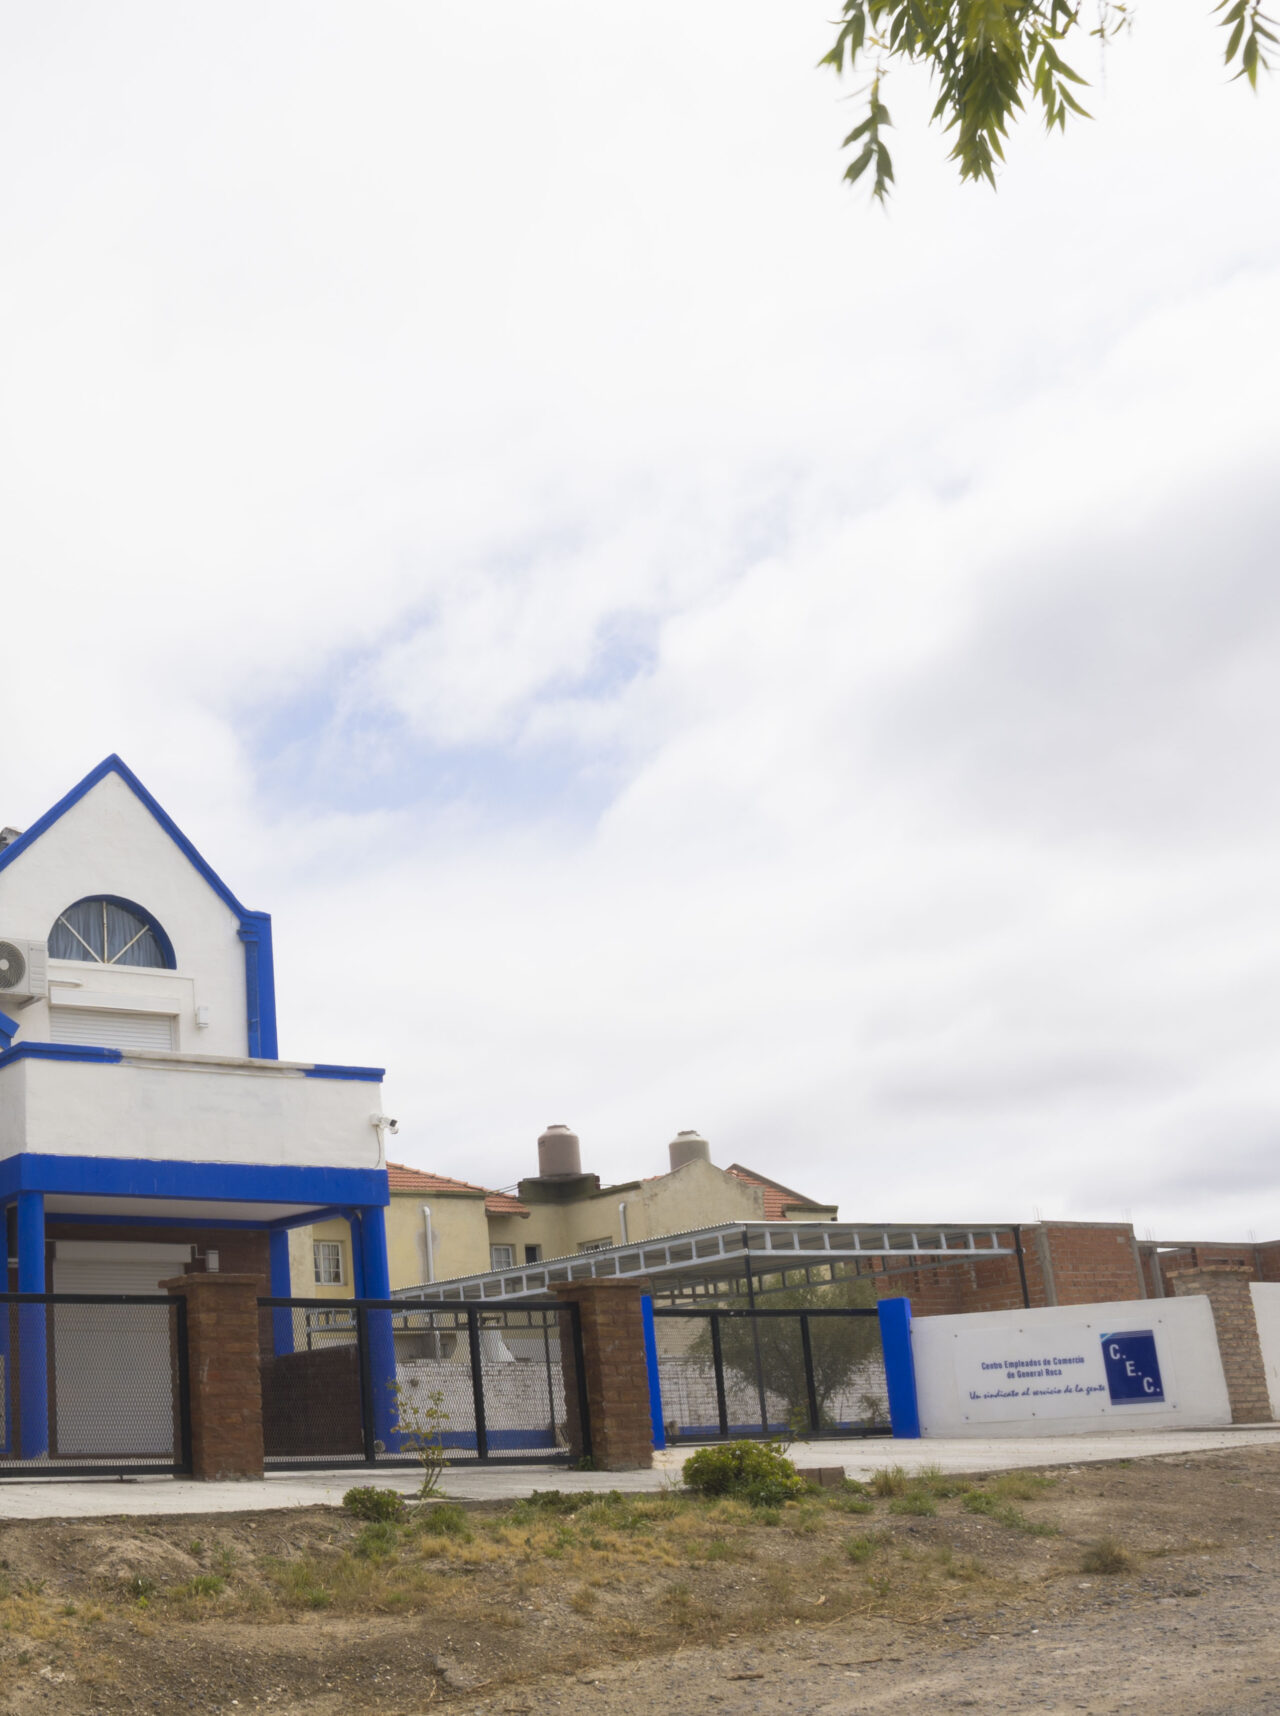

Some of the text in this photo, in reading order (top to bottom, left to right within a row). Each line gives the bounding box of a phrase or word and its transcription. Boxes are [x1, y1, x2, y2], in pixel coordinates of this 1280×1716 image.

[981, 1362, 1002, 1370] Centro
[1004, 1360, 1041, 1369] Empleados
[1053, 1357, 1085, 1365] Comercio
[1007, 1368, 1062, 1379] de General Roca
[969, 1384, 1105, 1400] Un sindicato al servicio de la gente
